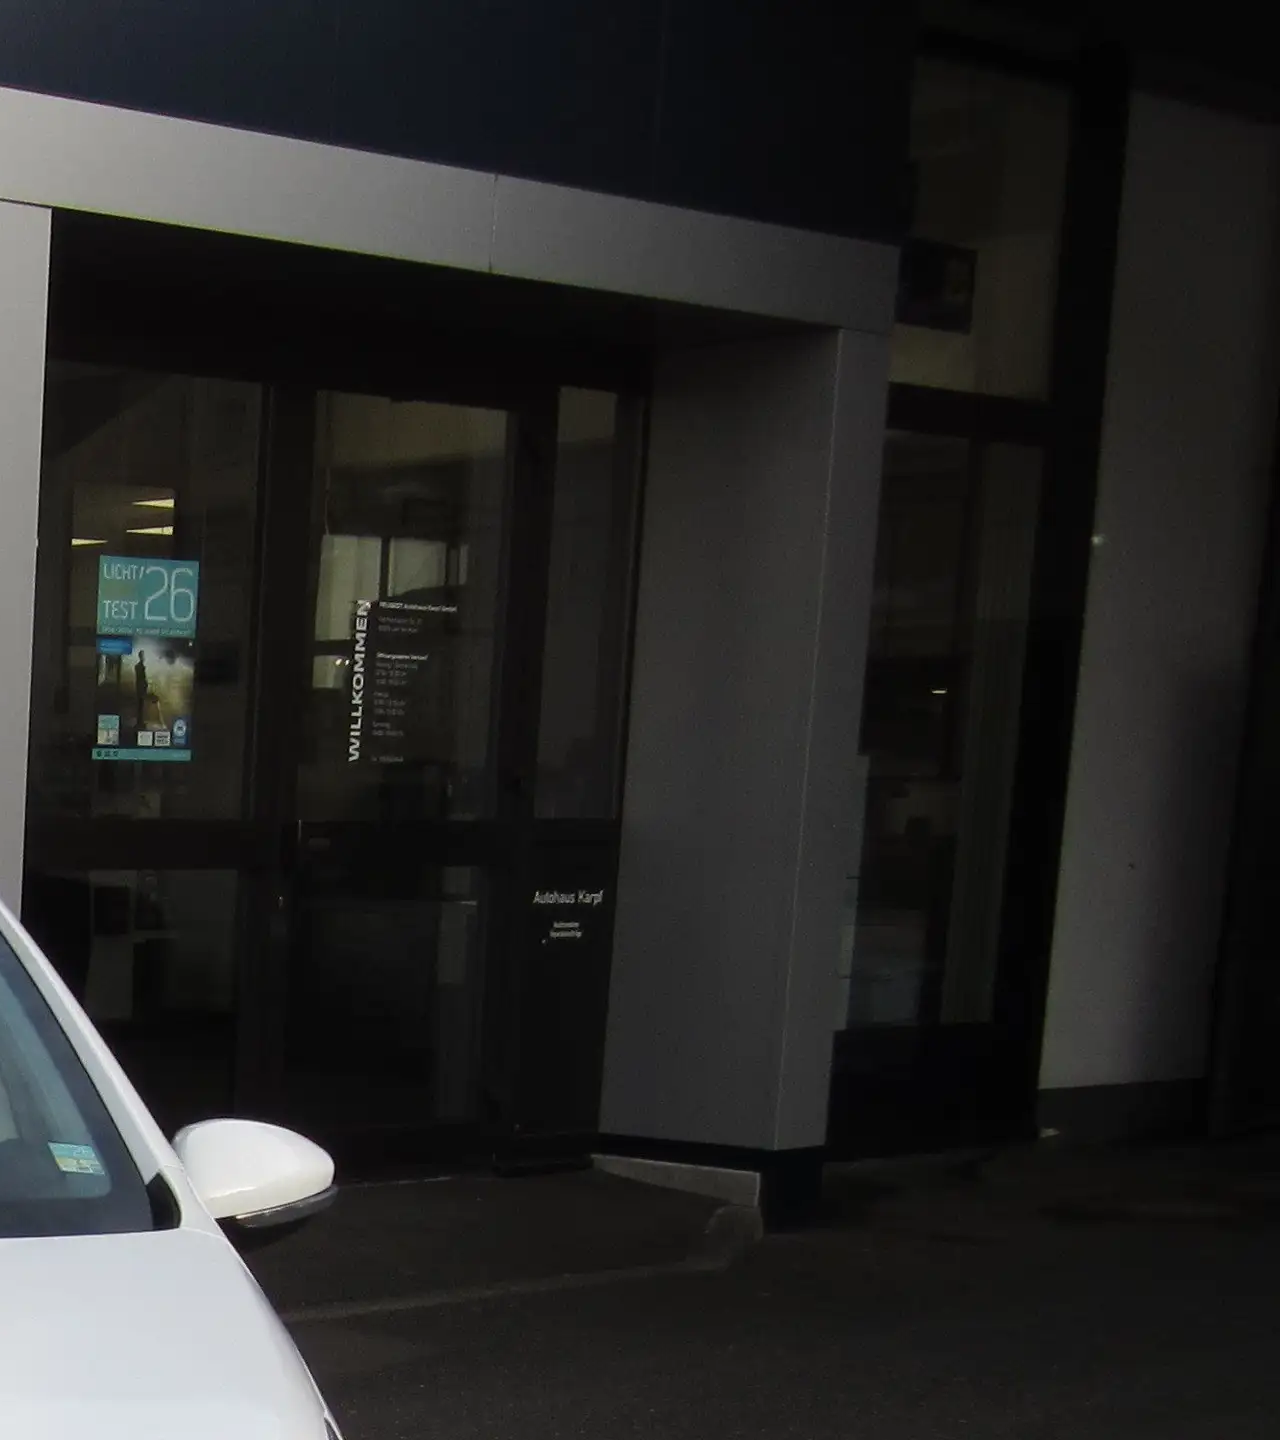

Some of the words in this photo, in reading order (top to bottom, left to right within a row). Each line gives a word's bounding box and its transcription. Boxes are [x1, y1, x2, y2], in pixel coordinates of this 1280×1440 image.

[103, 600, 139, 619] TEST
[348, 600, 371, 761] WILLKOMMEN
[533, 890, 575, 904] Autohaus
